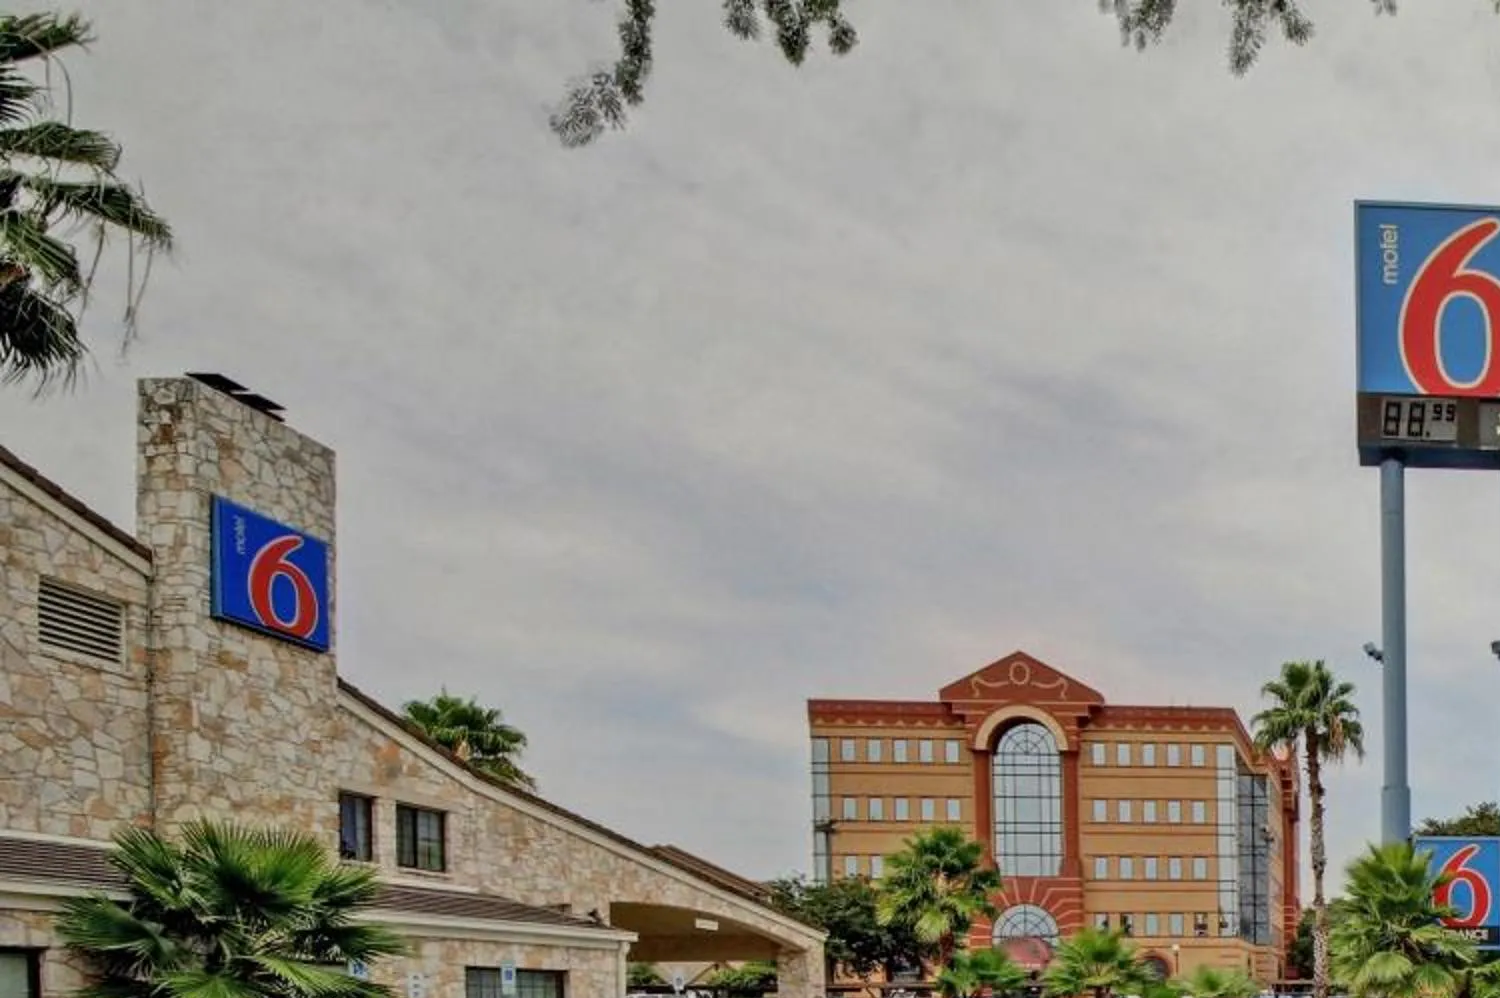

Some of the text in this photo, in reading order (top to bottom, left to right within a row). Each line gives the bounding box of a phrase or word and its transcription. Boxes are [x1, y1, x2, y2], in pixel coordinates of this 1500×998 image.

[1379, 223, 1399, 285] motel
[248, 535, 318, 639] 6
[1431, 844, 1491, 929] 6
